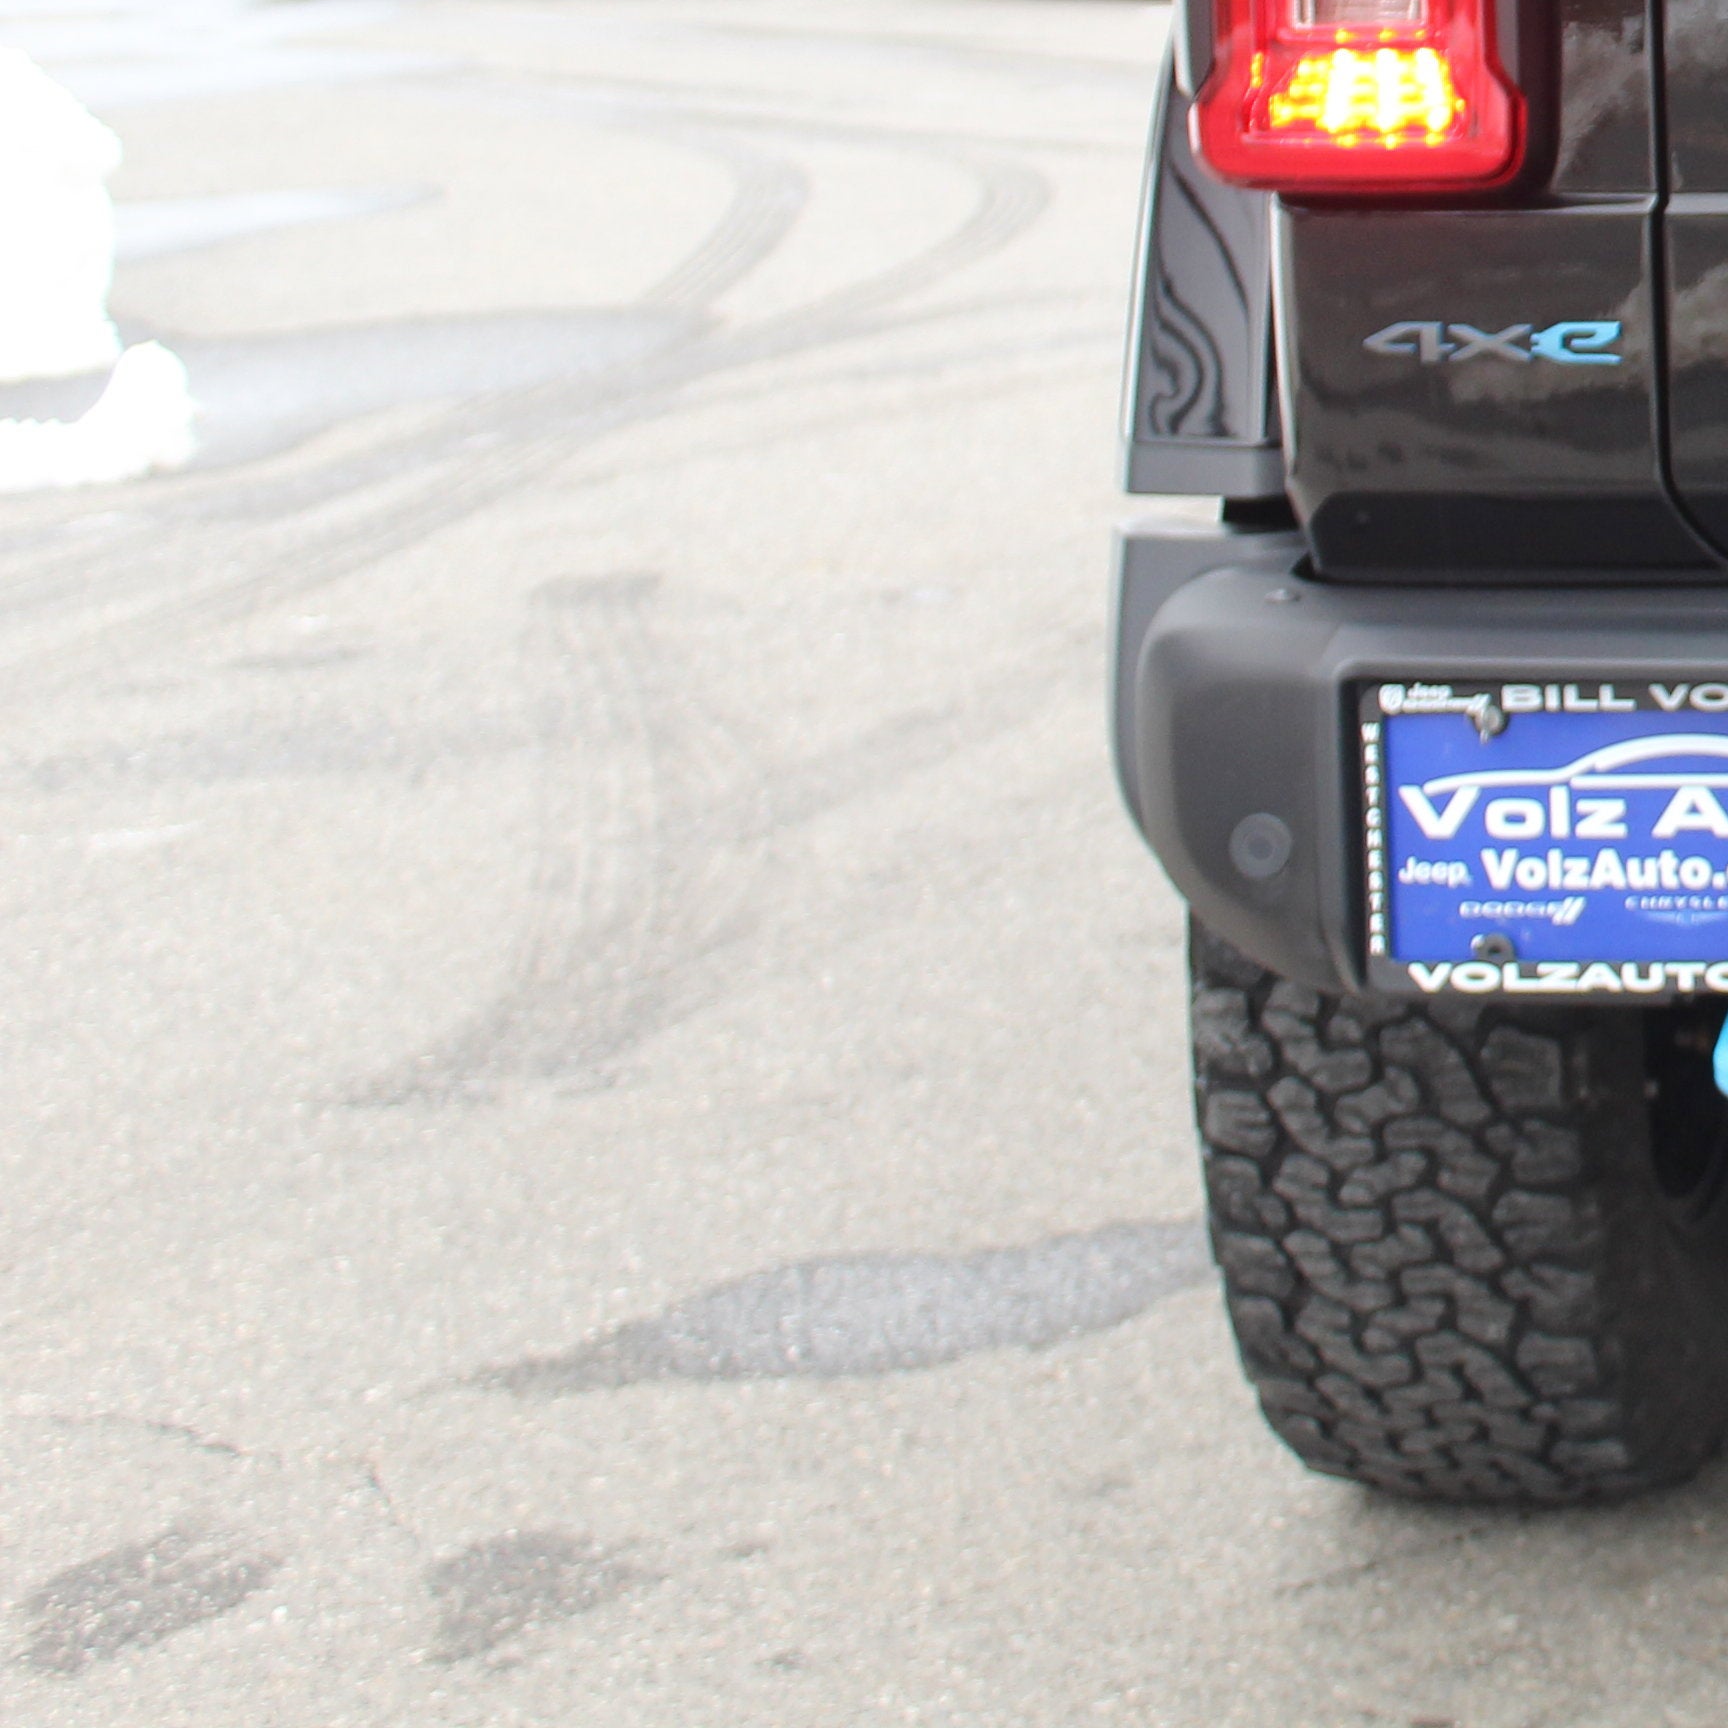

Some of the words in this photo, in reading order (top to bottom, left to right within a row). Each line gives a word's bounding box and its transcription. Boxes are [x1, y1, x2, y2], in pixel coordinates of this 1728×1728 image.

[1501, 683, 1637, 713] BILL
[1400, 784, 1629, 840] Volz
[1398, 856, 1470, 889] Jeep
